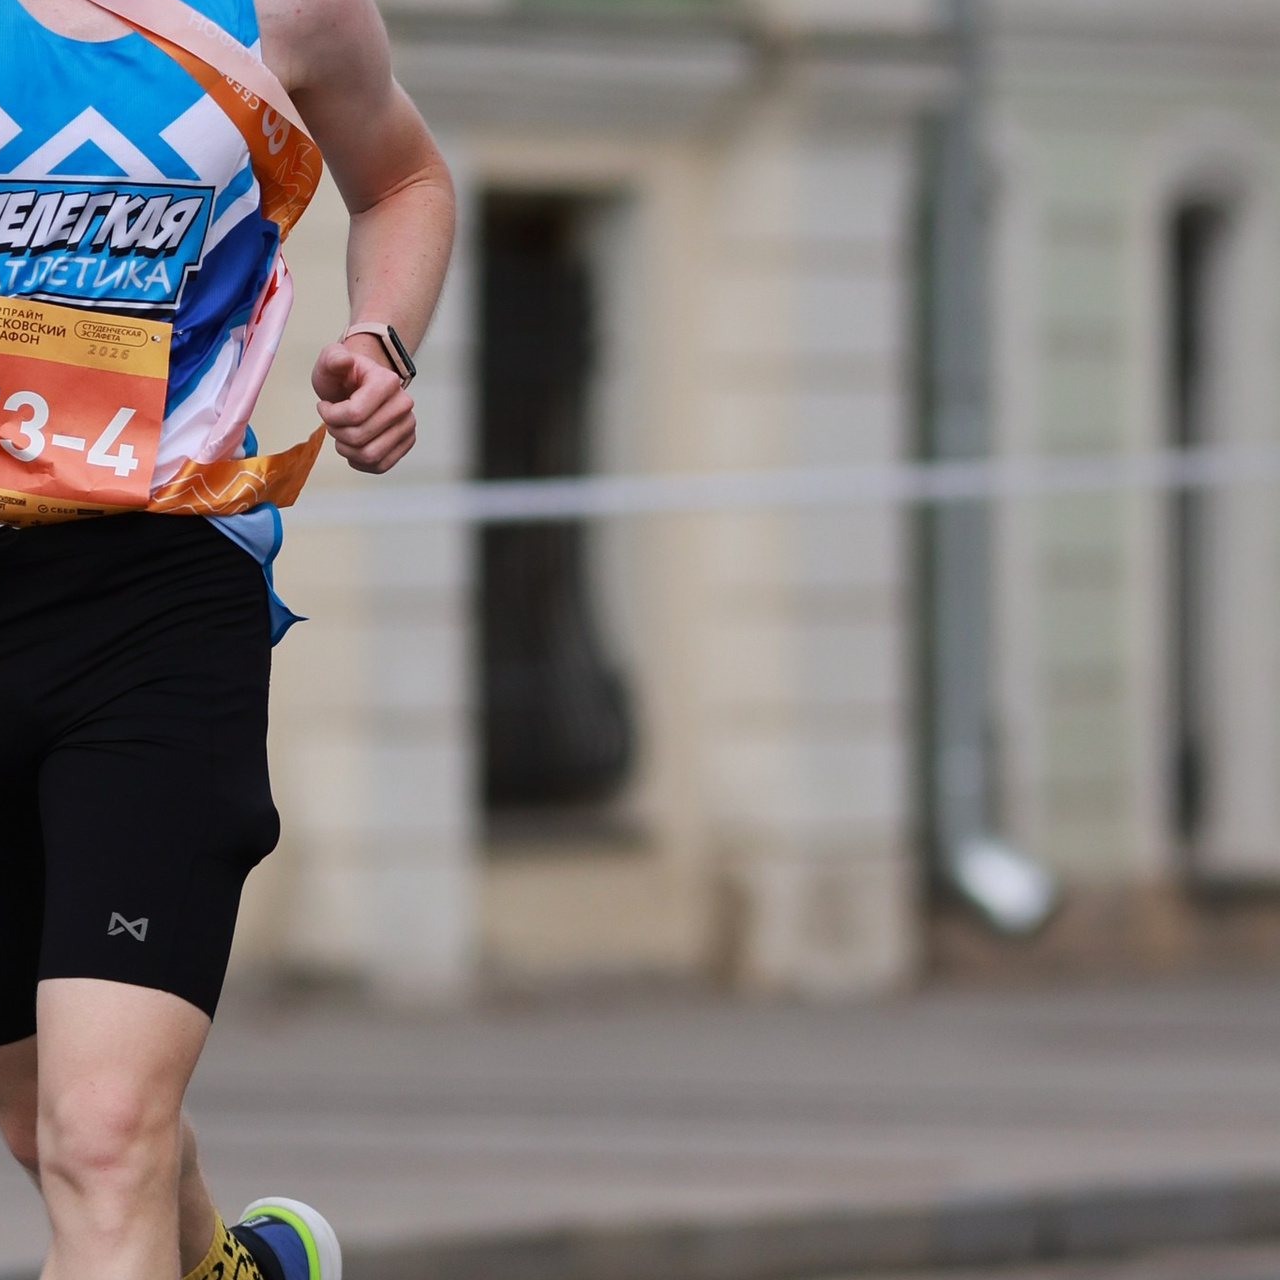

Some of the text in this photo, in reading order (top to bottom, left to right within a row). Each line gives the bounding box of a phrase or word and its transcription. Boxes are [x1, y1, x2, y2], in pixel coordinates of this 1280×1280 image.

[81, 329, 121, 342] ЭСТАФЕТА
[82, 323, 142, 337] СТУДЕНЧЕСКАЯ
[87, 344, 130, 360] 2026
